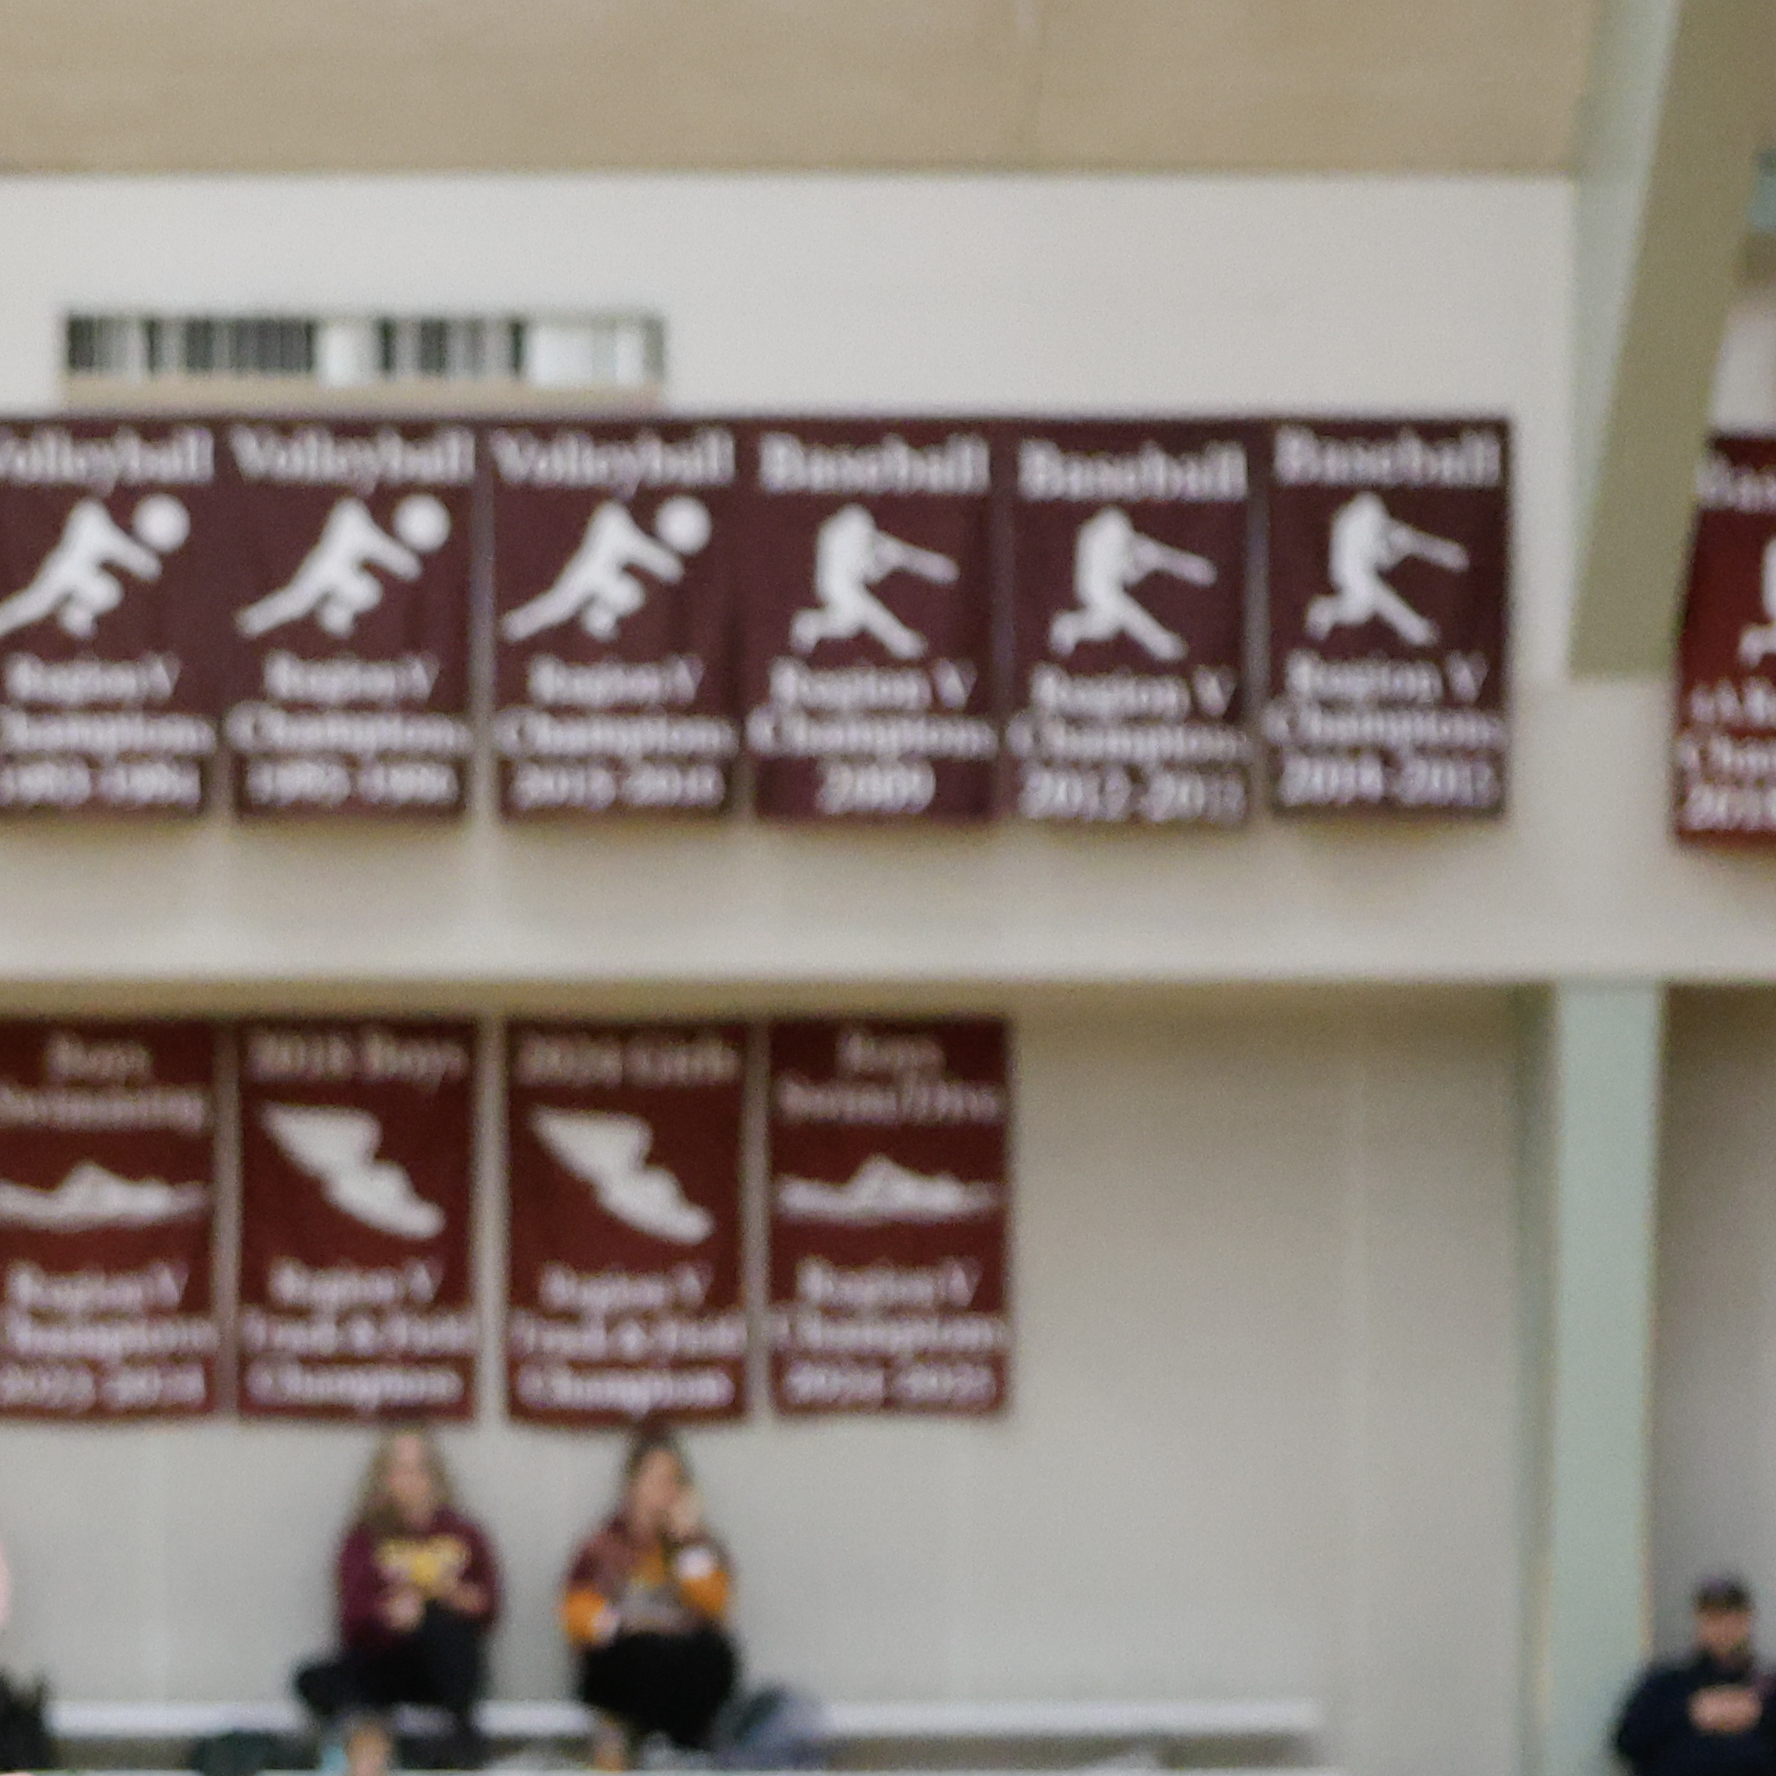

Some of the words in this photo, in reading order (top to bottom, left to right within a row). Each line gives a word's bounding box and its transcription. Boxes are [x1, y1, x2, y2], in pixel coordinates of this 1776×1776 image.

[228, 426, 476, 497] Volleyball
[489, 427, 736, 499] Volleyball
[760, 432, 990, 494] Baseball
[1017, 439, 1247, 502] Baseball
[1274, 426, 1501, 488] Baseball
